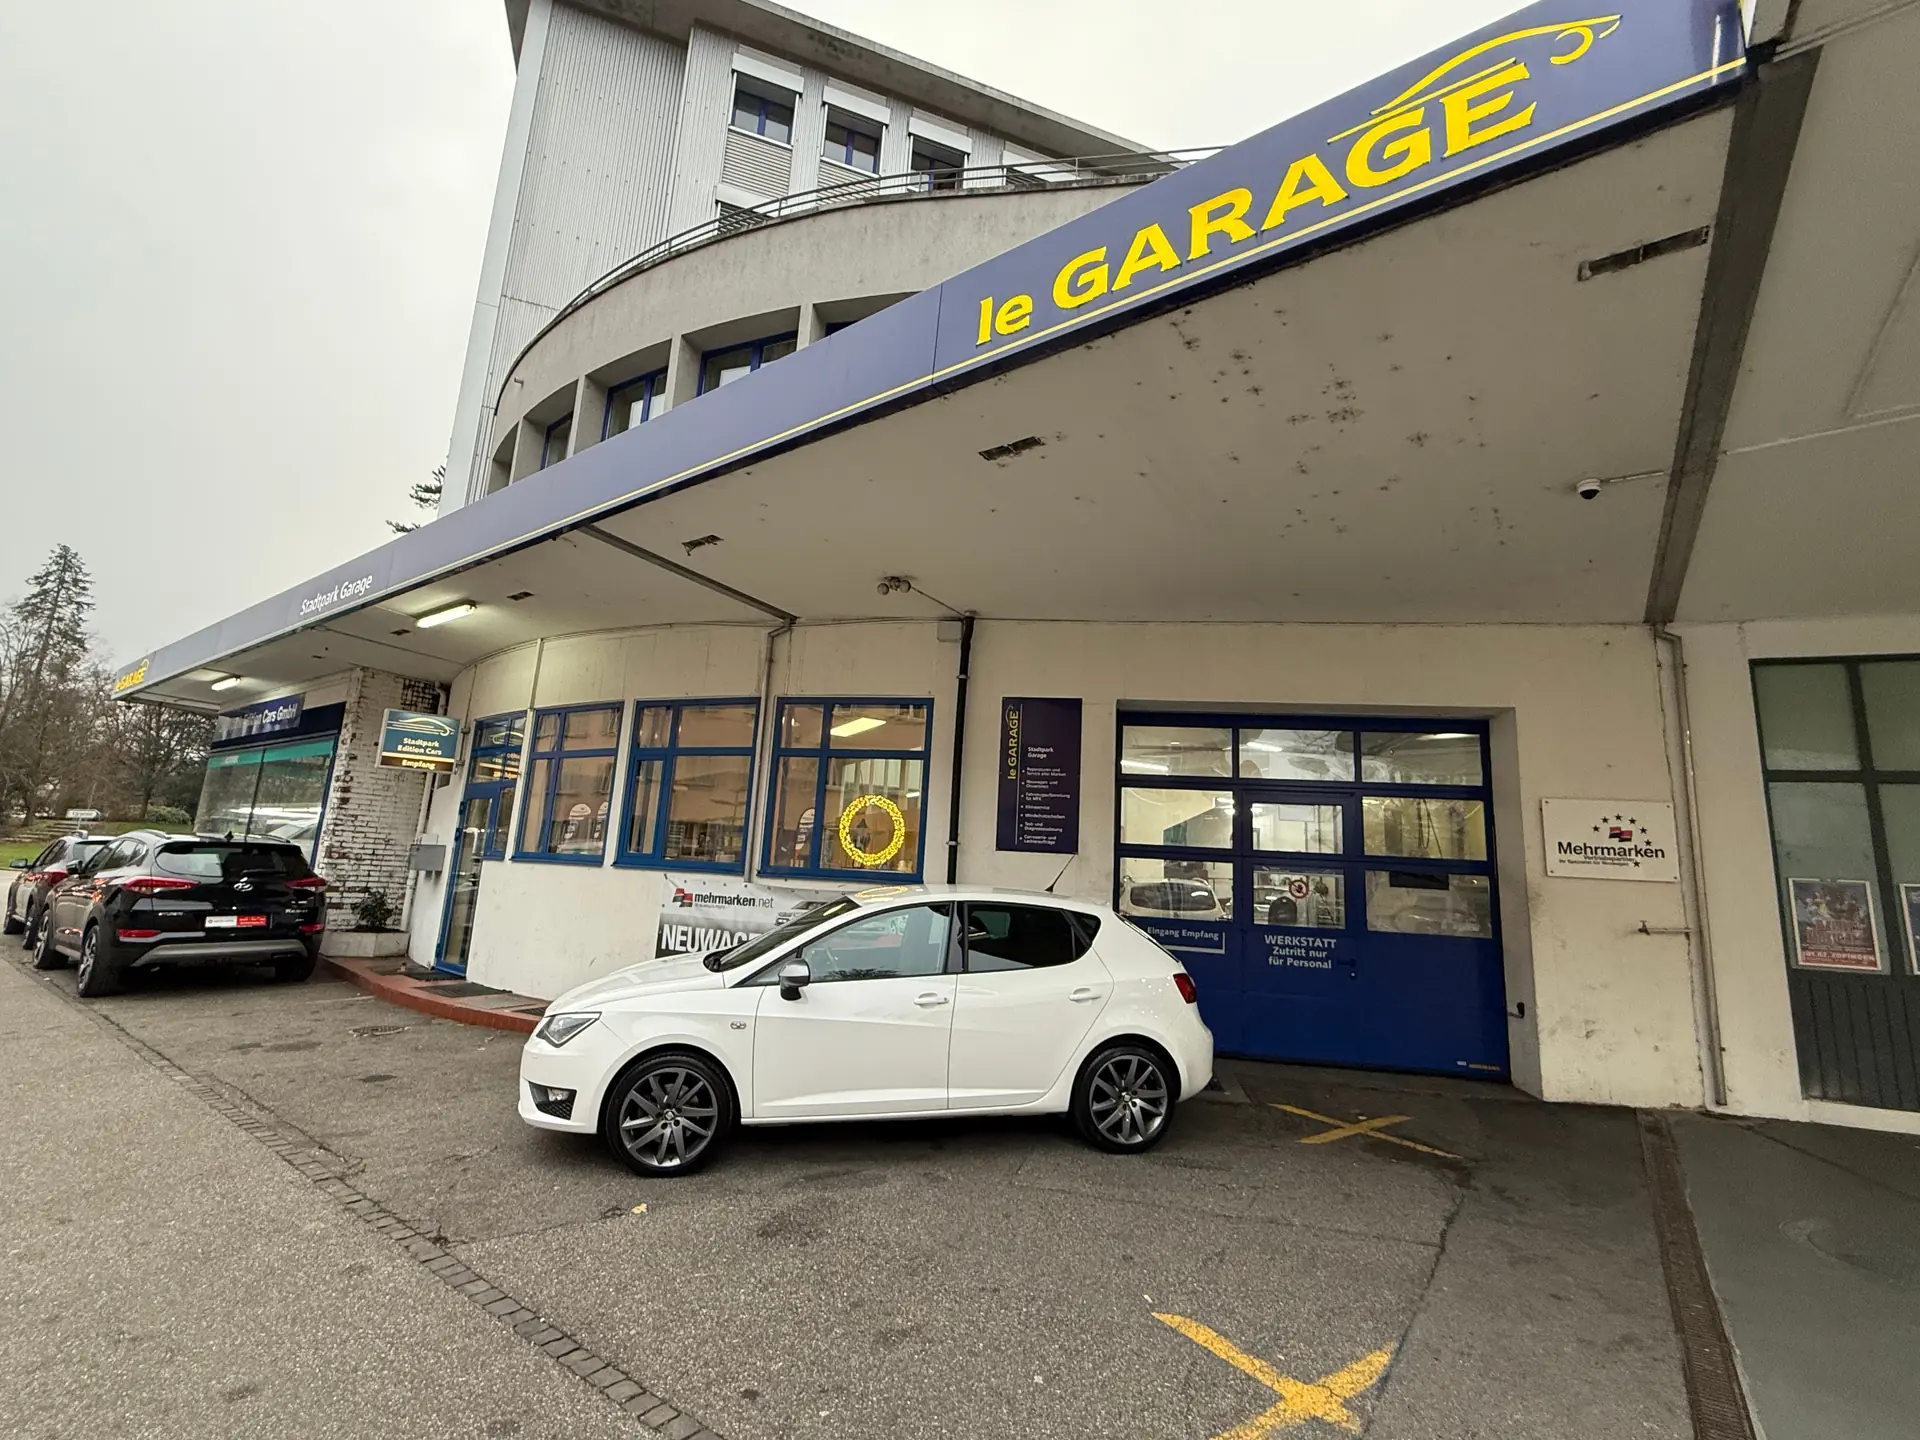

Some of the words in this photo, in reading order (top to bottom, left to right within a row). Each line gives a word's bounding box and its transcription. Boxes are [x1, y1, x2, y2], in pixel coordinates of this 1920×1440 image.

[975, 294, 1033, 345] le
[1052, 63, 1538, 309] GARAGE
[300, 585, 339, 615] Stadtpark
[340, 575, 373, 599] Garage
[262, 709, 277, 723] Cars
[277, 703, 298, 721] GmbH
[403, 737, 440, 748] Stadtpark
[1008, 710, 1019, 767] GARAGE
[397, 745, 425, 753] Edition
[402, 759, 436, 770] Empfang
[1007, 769, 1017, 780] le
[1557, 841, 1665, 858] Mehrmarken
[694, 892, 774, 909] mehrmarken.net
[1147, 926, 1179, 938] Eingang
[1181, 928, 1219, 941] Empfang
[1264, 934, 1337, 948] WERKSTATT
[1273, 946, 1306, 957] Zutritt
[1309, 949, 1328, 958] nur
[1268, 956, 1284, 966] für
[1287, 957, 1332, 969] Personal
